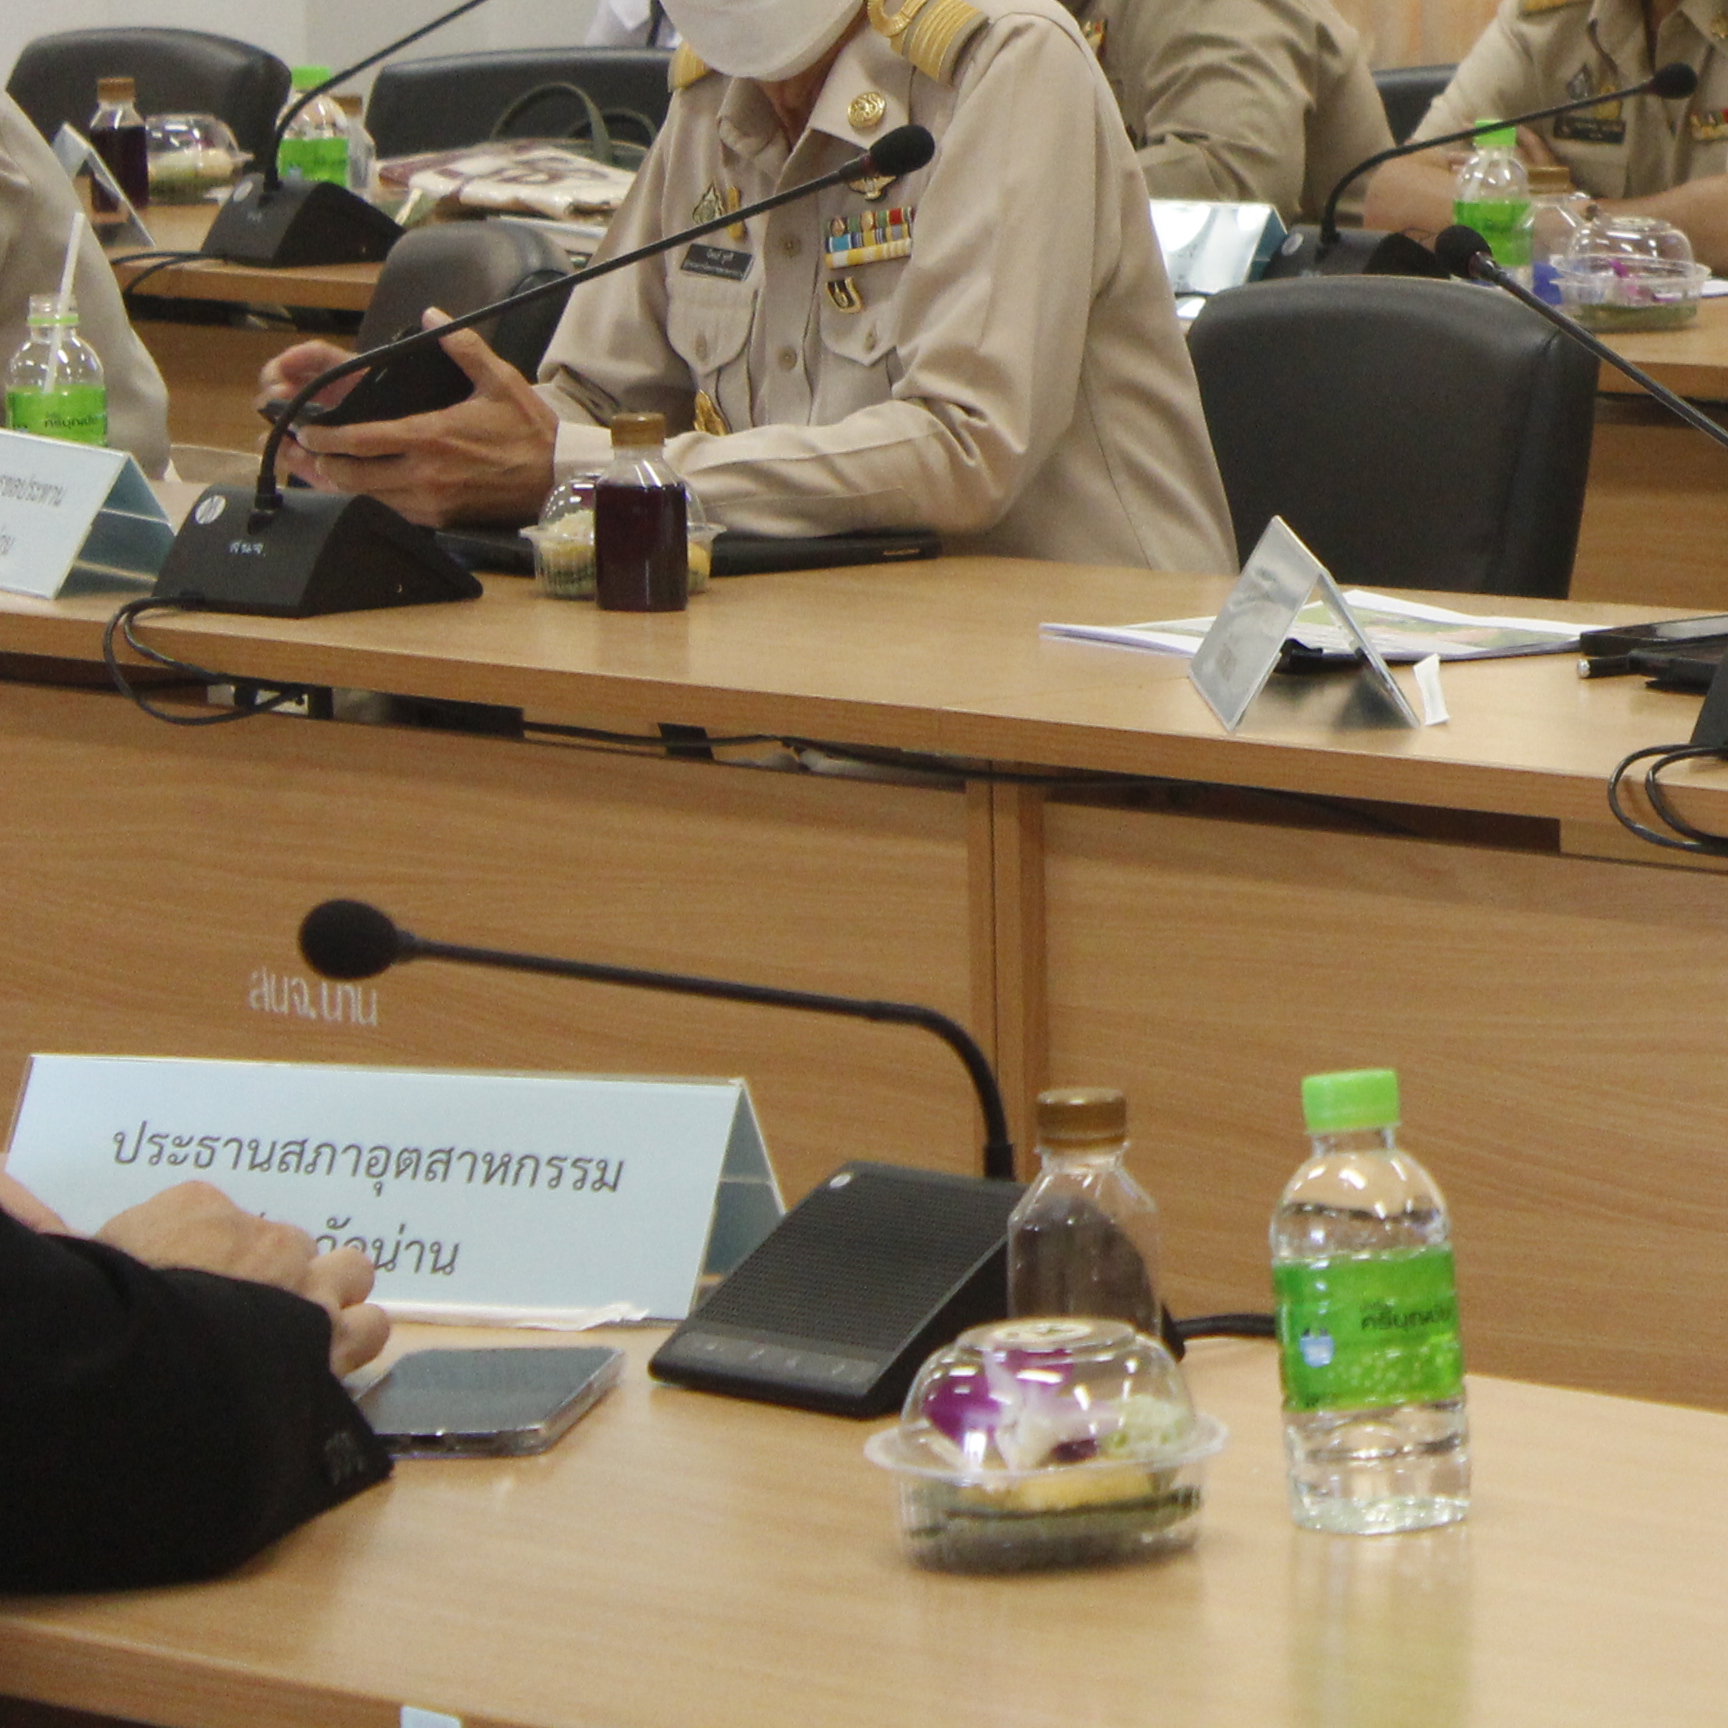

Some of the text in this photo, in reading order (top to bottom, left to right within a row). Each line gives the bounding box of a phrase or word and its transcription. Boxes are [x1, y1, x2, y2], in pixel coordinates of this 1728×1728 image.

[111, 1120, 625, 1197] ประธานสภาอุตสาหกรรม
